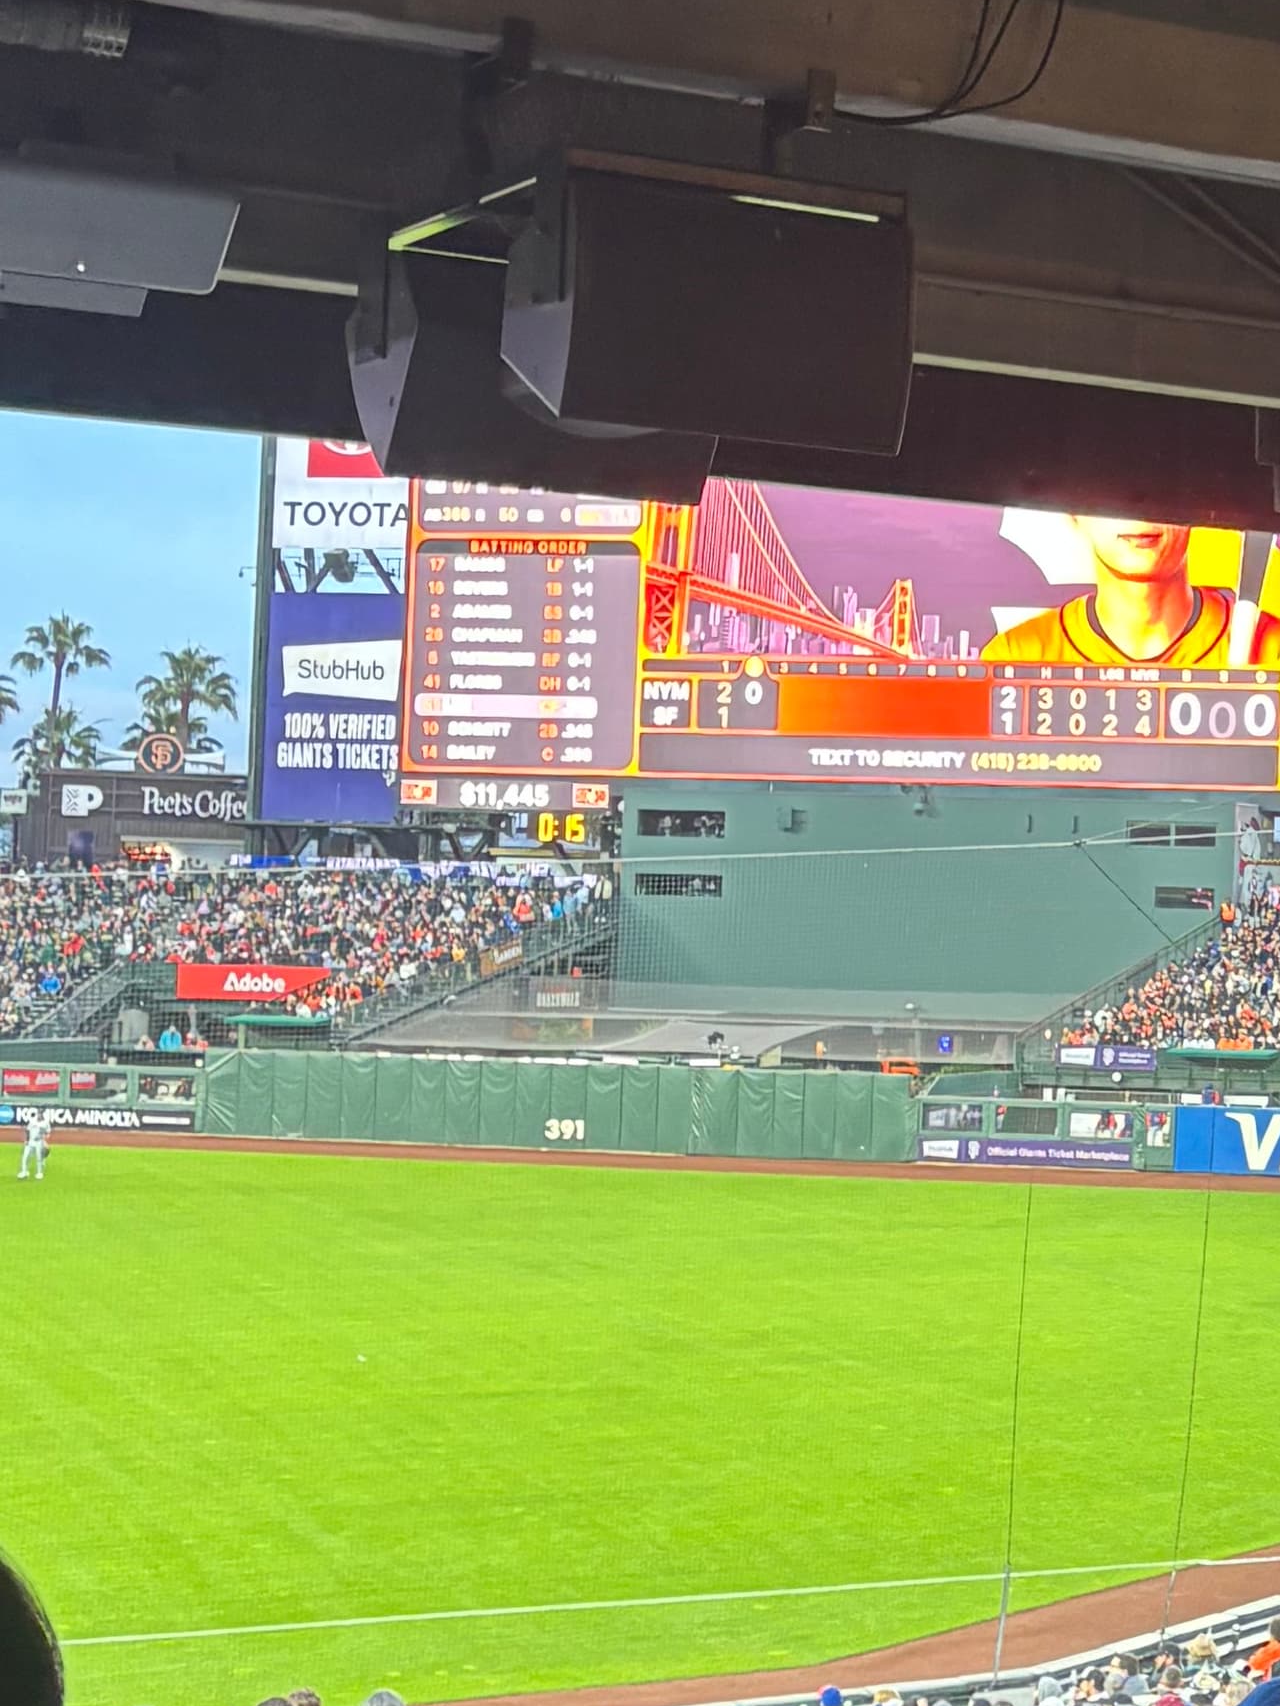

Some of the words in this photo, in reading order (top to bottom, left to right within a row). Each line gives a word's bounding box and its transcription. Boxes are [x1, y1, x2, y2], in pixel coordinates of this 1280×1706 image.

[284, 501, 409, 528] TOYOTA
[470, 540, 534, 554] BATTING
[538, 541, 587, 555] ORDER
[429, 556, 446, 572] 17
[546, 558, 564, 573] LF
[573, 558, 594, 573] 1-1
[572, 581, 594, 597] 1-1
[430, 604, 441, 619] 2
[297, 658, 385, 681] StubHub
[722, 660, 730, 673] 1
[779, 661, 789, 674] 3
[807, 662, 818, 675] 4
[838, 662, 848, 675] 5
[898, 663, 907, 676] 7
[1041, 666, 1052, 680] H
[423, 674, 441, 689] 41
[538, 676, 561, 691] DH
[643, 680, 690, 703] NYM
[717, 680, 732, 704] 2
[744, 680, 763, 705] 0
[999, 686, 1017, 709] 2
[1037, 687, 1053, 710] 3
[1069, 687, 1087, 711] 0
[1105, 689, 1116, 711] 1
[1135, 689, 1152, 712] 3
[284, 712, 325, 739] 100%
[329, 713, 397, 740] VERIFIED
[652, 705, 678, 726] SF
[718, 706, 730, 729] 1
[1000, 711, 1013, 734] 1
[1036, 712, 1052, 736] 2
[1068, 713, 1086, 736] 0
[1102, 714, 1118, 737] 2
[1135, 714, 1152, 737] 4
[1169, 692, 1202, 736] 0
[1208, 701, 1237, 739] 0
[1244, 693, 1276, 737] 0
[422, 721, 440, 736] 10
[276, 741, 334, 769] GIANTS
[336, 742, 399, 771] TICKETS
[421, 744, 438, 759] 14
[541, 747, 554, 761] C
[808, 748, 854, 767] TEXT
[856, 748, 880, 767] TO
[882, 749, 966, 769] SECURITY
[140, 786, 193, 818] Peet's
[537, 811, 586, 843] 0:15
[223, 971, 286, 994] Adobe
[75, 1109, 140, 1128] MINOLTA
[545, 1118, 586, 1141] 391
[987, 1145, 1017, 1158] Official
[1018, 1147, 1047, 1159] Giants
[1048, 1149, 1074, 1160] Ticket
[1075, 1149, 1130, 1163] Marketplace
